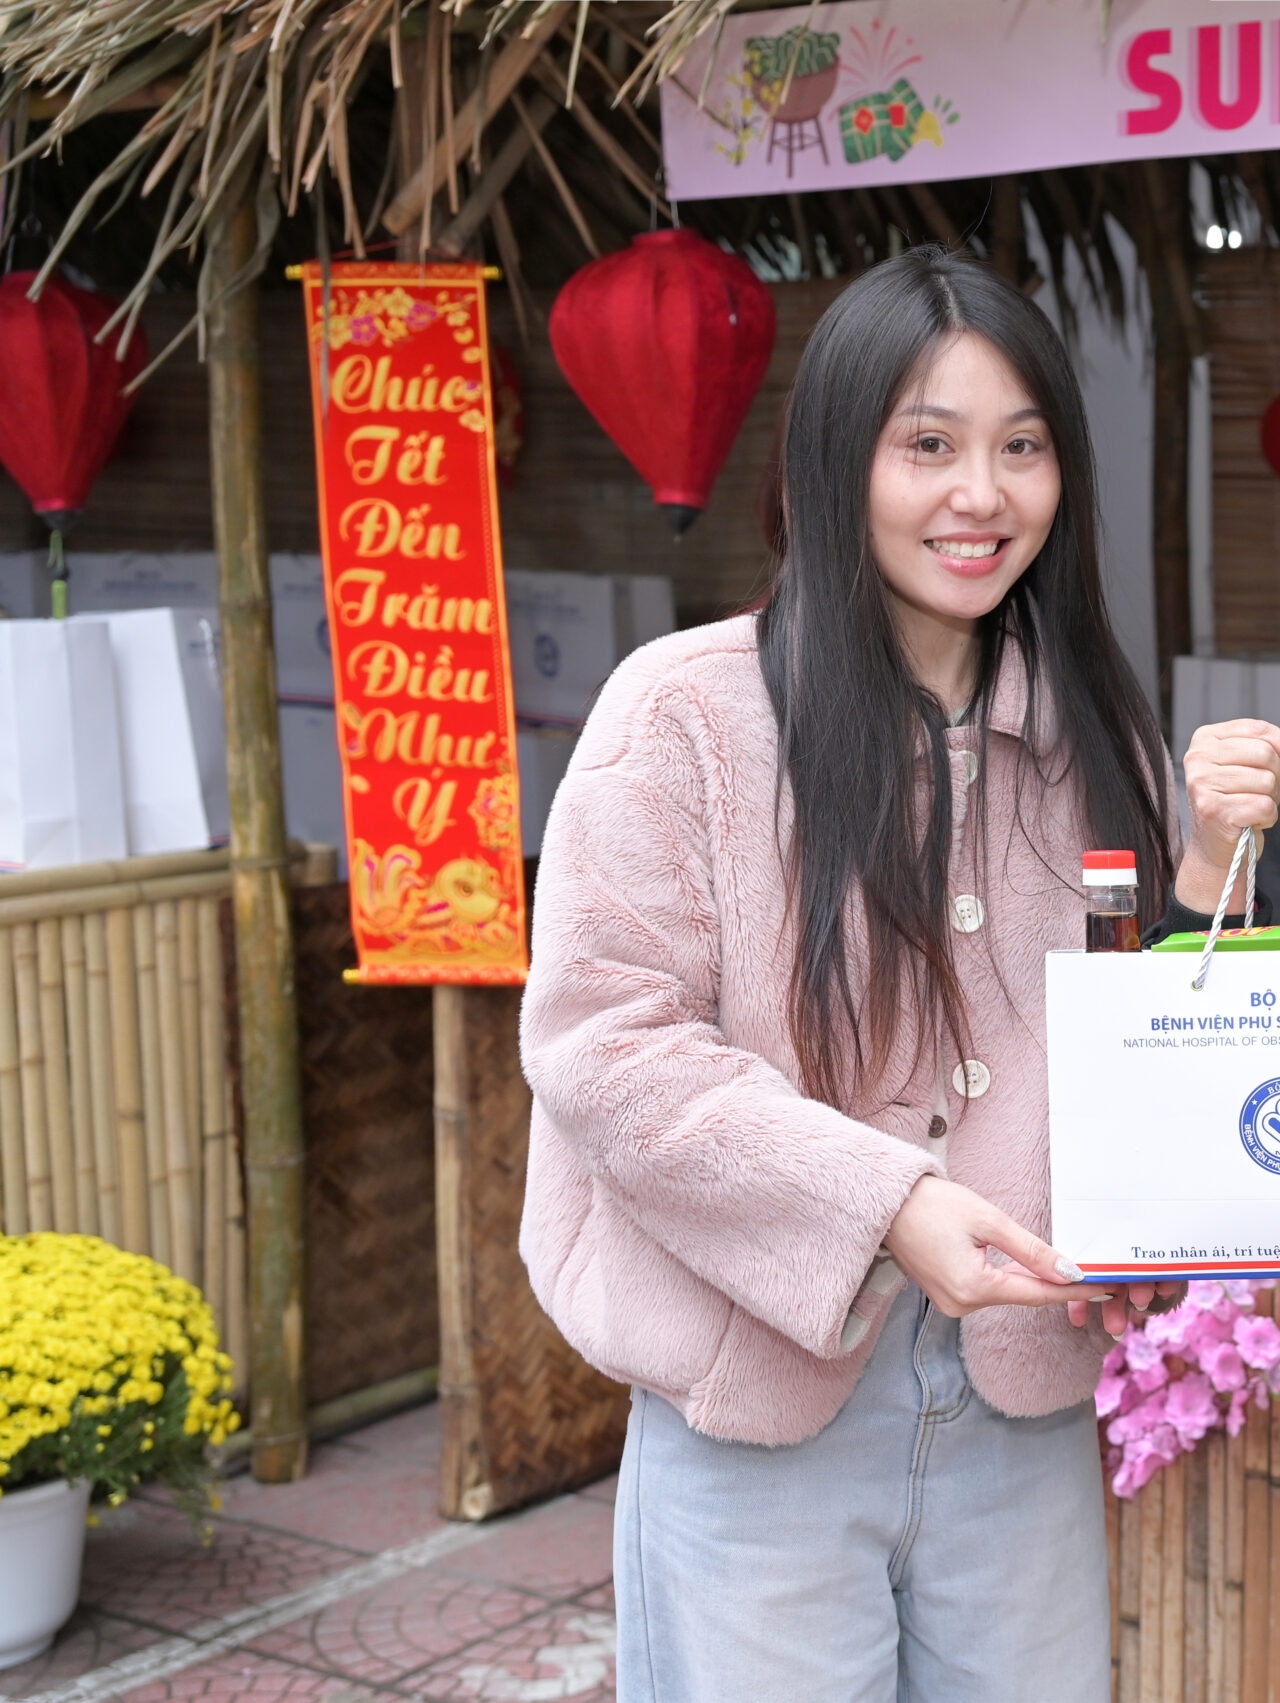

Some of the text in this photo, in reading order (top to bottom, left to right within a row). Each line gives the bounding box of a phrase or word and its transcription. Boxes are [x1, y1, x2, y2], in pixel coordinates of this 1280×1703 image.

[331, 354, 471, 414] Chúc
[345, 425, 447, 486] Tết
[339, 498, 467, 560] Đến
[334, 567, 495, 634] Trăm
[347, 640, 494, 702] Điều
[358, 708, 496, 768] Như
[393, 767, 457, 846] Ý
[1151, 1015, 1194, 1035] BỆNH
[1197, 1014, 1235, 1034] VIỆN
[1238, 1015, 1272, 1033] PHỤ
[1250, 989, 1276, 1011] BỘ
[1123, 1037, 1179, 1048] NATIONAL
[1182, 1036, 1239, 1047] HOSPITAL
[1242, 1036, 1257, 1046] OF
[1267, 1082, 1280, 1094] BỘ
[1131, 1246, 1166, 1259] Trao
[1170, 1246, 1207, 1258] nhân
[1212, 1246, 1230, 1259] ái,
[1234, 1244, 1252, 1257] trí
[1257, 1245, 1280, 1259] tuệ
